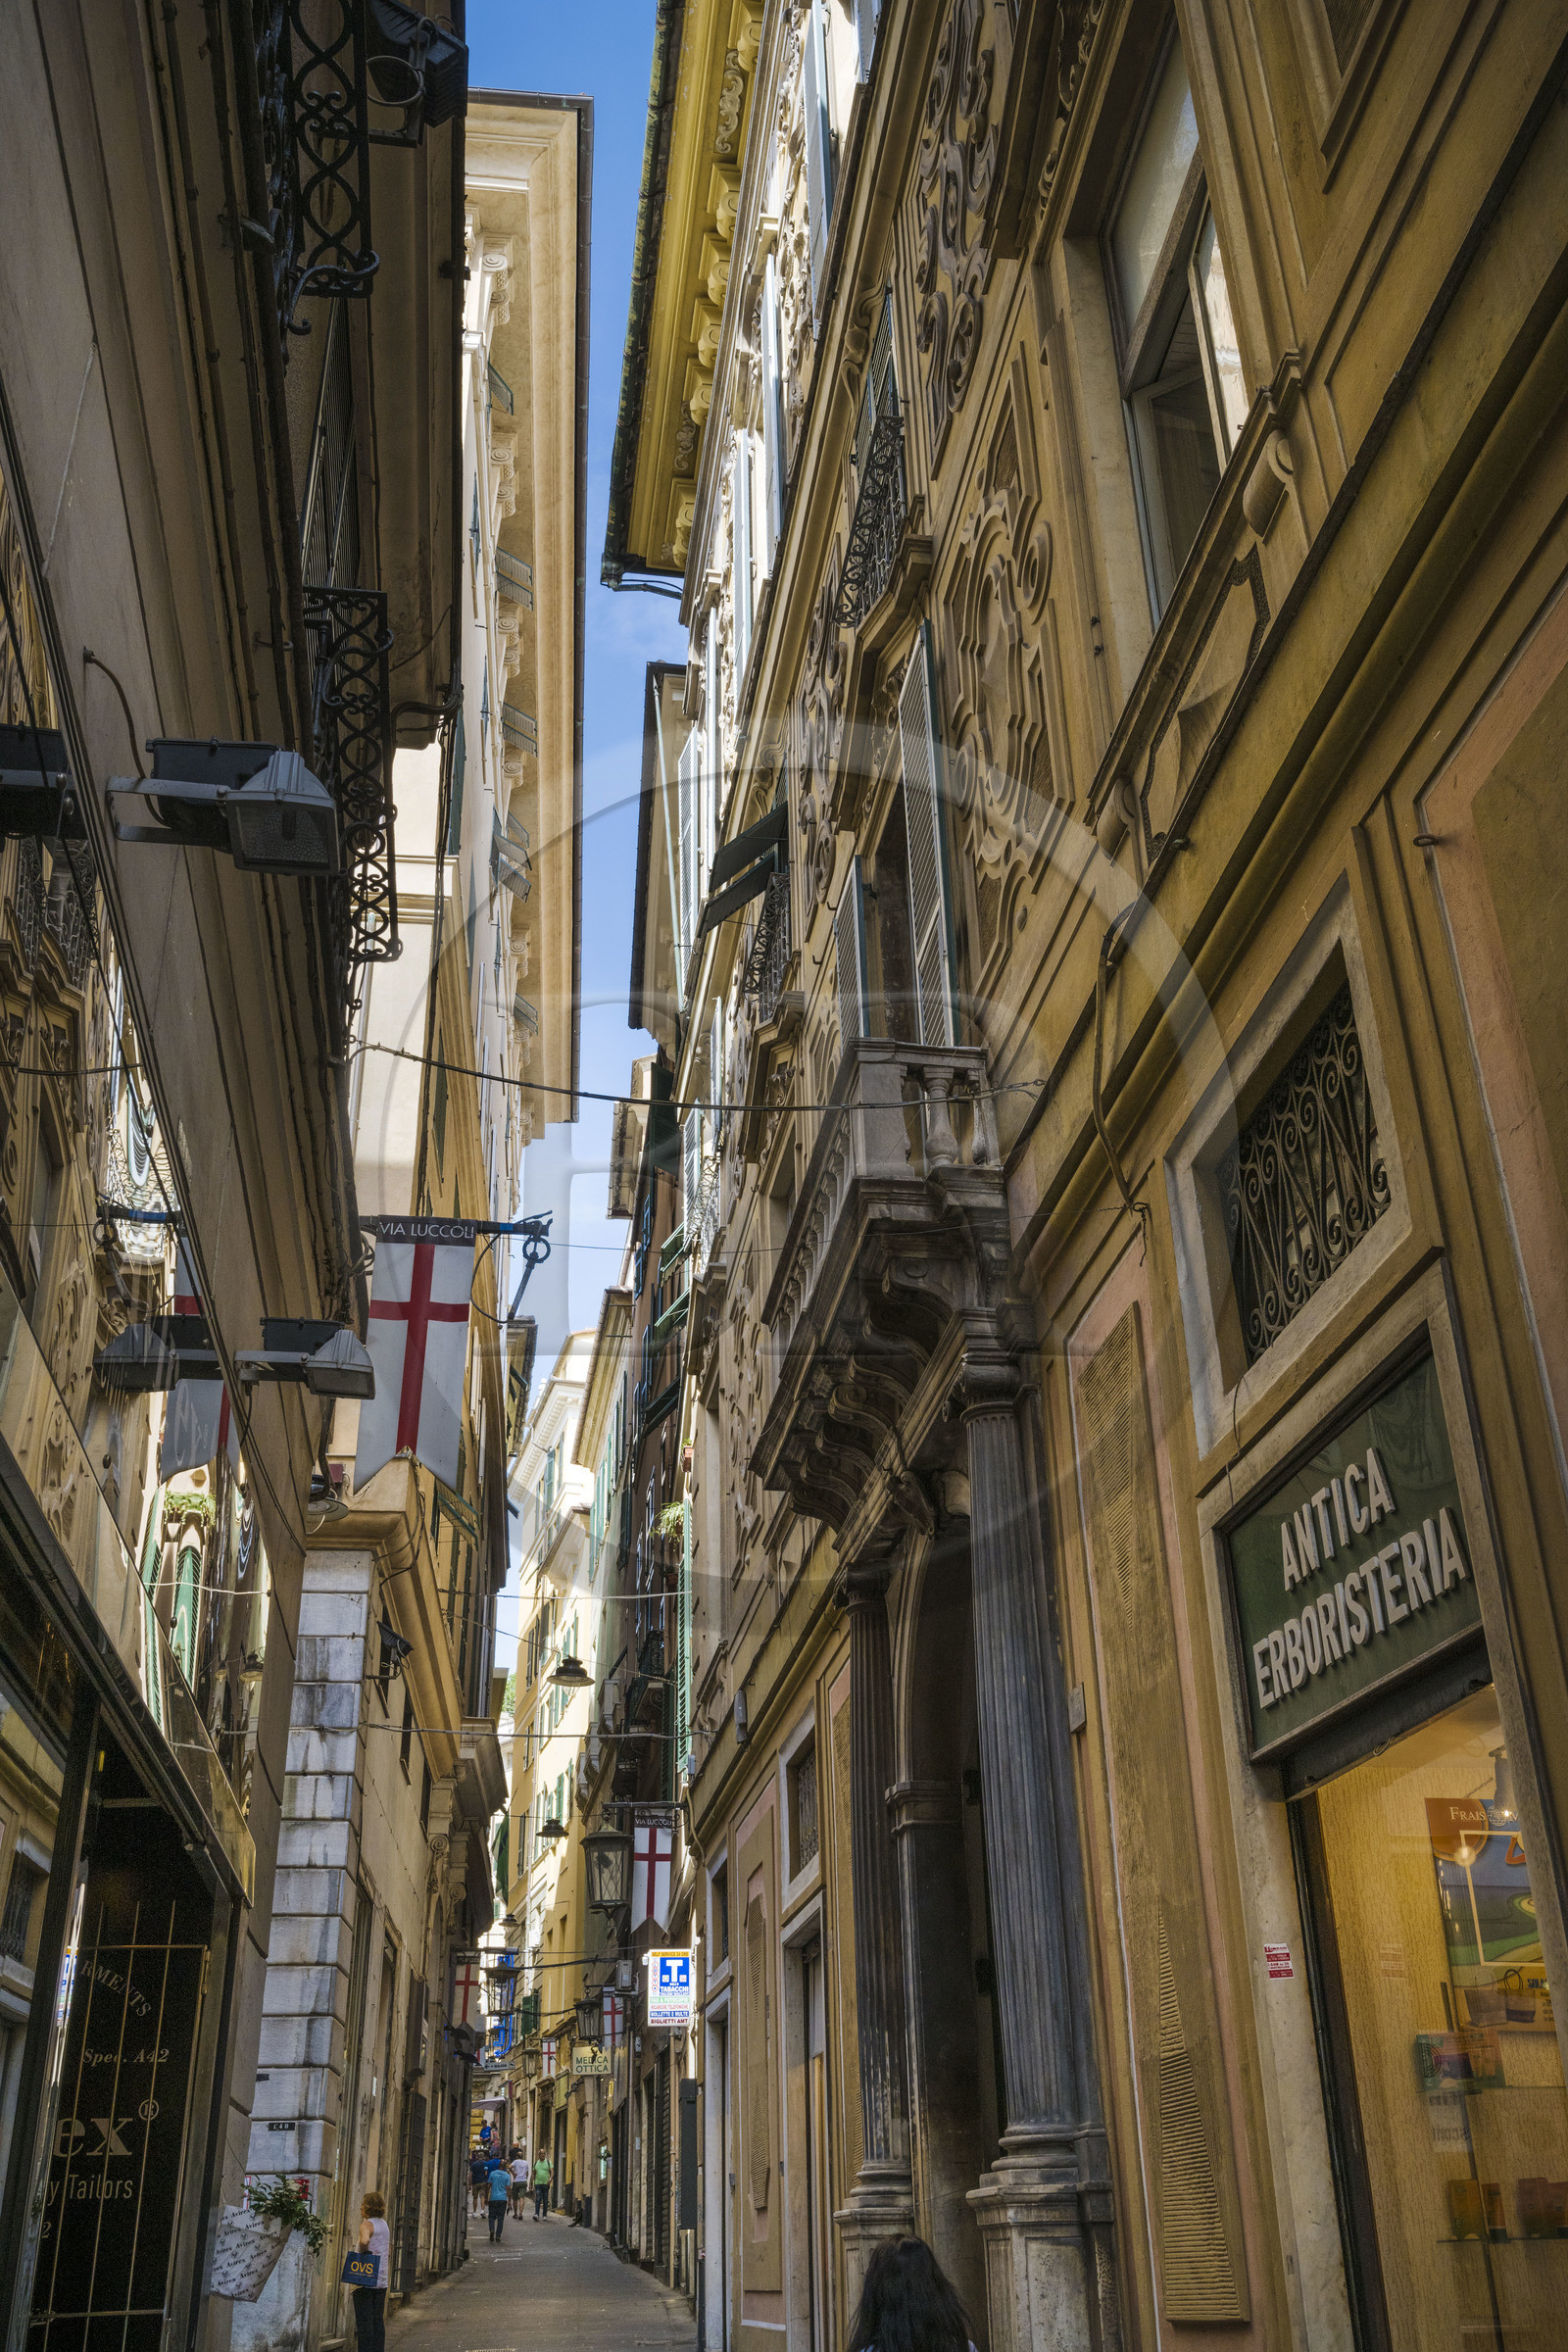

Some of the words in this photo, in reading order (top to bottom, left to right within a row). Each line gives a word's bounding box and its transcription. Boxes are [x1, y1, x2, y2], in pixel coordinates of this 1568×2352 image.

[379, 1222, 406, 1236] VIA
[411, 1223, 474, 1239] LUCCOLI
[1280, 1446, 1396, 1592] ANTICA
[1252, 1506, 1471, 1710] ERBORISTERIA
[665, 1959, 683, 1983] T
[82, 2048, 127, 2067] Spec.
[133, 2048, 170, 2063] A42
[69, 2174, 133, 2200] Tailors
[231, 2209, 251, 2218] Avirex
[223, 2228, 242, 2237] Avirex
[245, 2221, 265, 2230] Avirex
[235, 2239, 255, 2249] Avirex
[226, 2258, 246, 2268] Avirex
[351, 2261, 373, 2275] OVS
[218, 2278, 236, 2287] Avirex
[239, 2269, 259, 2279] Avirex
